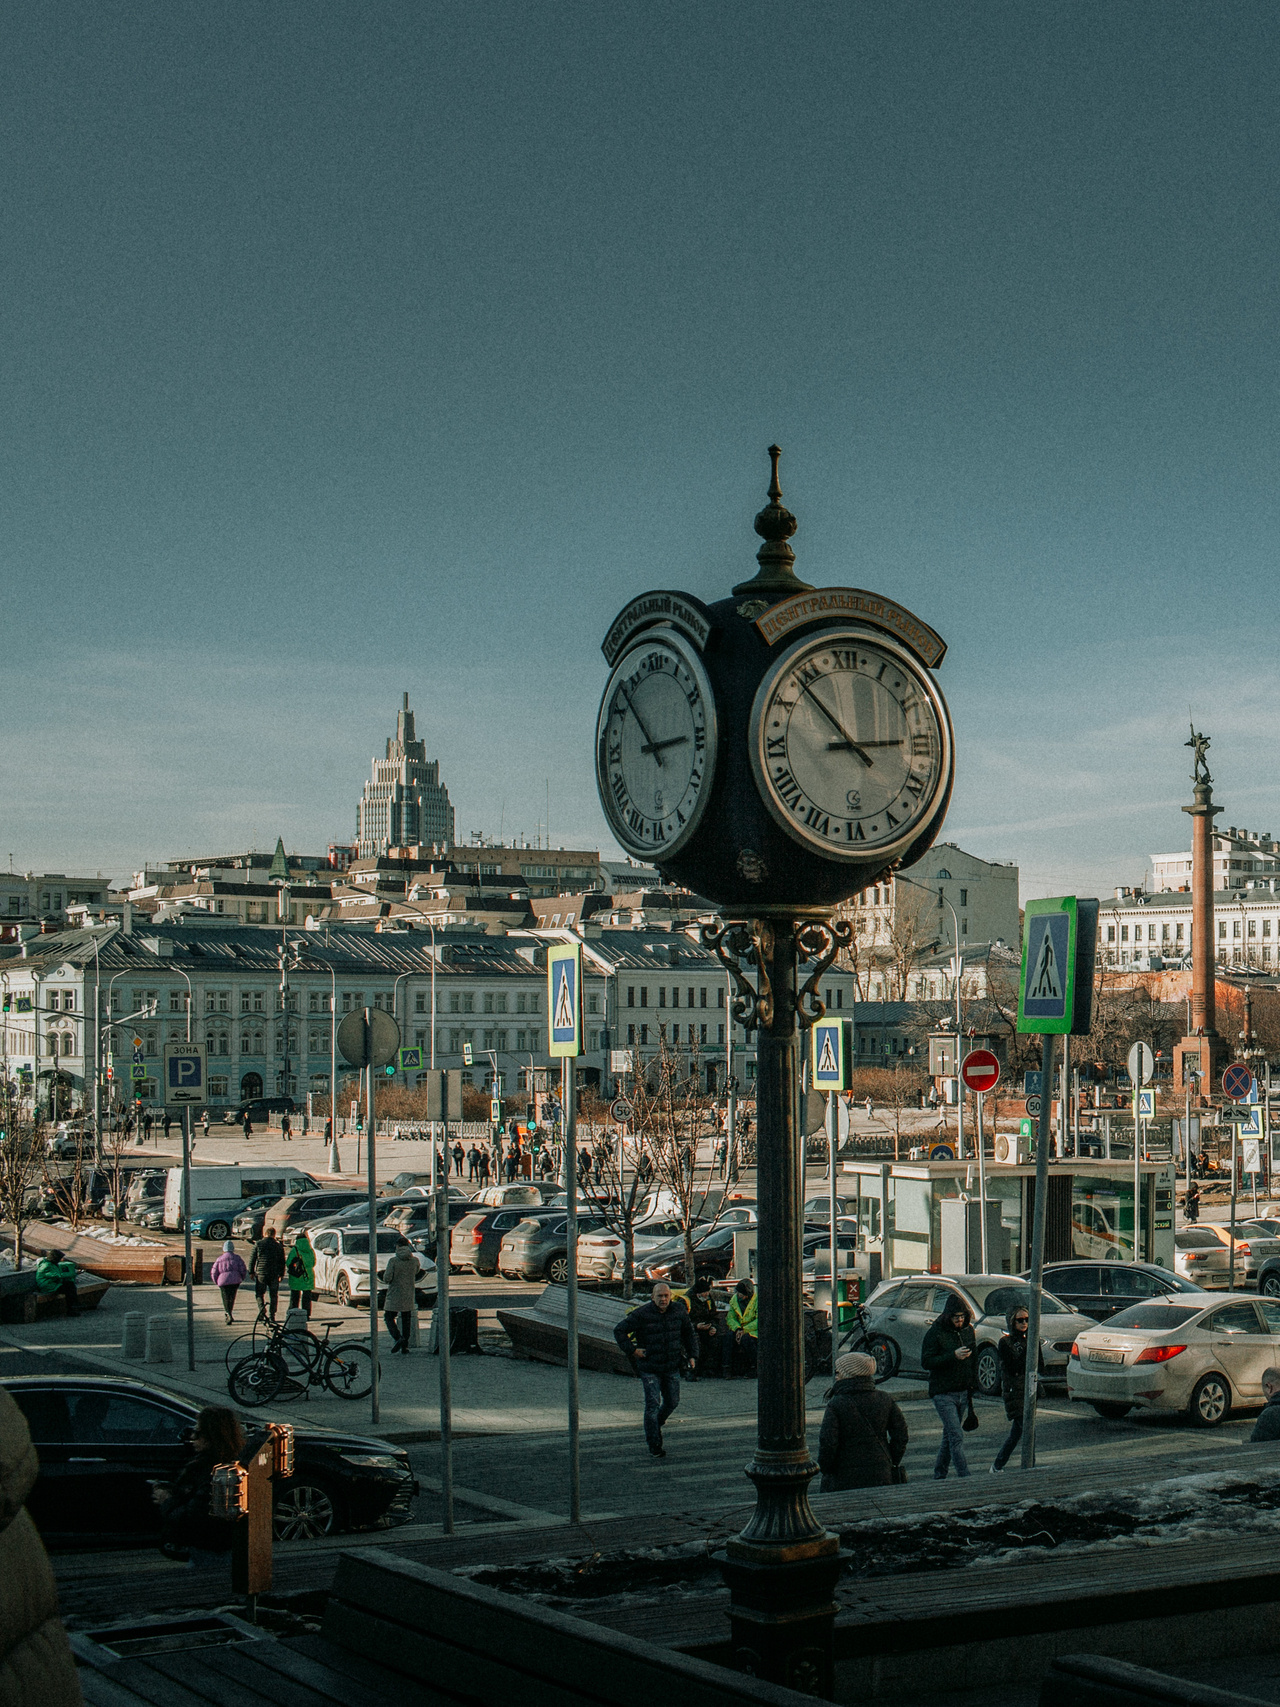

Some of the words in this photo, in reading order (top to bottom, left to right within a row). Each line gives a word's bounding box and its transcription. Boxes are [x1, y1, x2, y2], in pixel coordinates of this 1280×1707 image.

[762, 594, 886, 636] ЦЕНТРАЛЬНЫЙ
[887, 609, 937, 659] РЫНОК
[831, 650, 859, 670] XII
[797, 658, 822, 686] XI
[876, 663, 888, 681] I
[773, 693, 793, 714] X
[767, 735, 786, 759] IX
[913, 734, 930, 756] III
[775, 769, 802, 811] VIII
[906, 774, 925, 799] IV
[804, 806, 830, 836] VII
[886, 810, 900, 829] V
[846, 822, 866, 841] VI
[174, 1046, 198, 1054] ЗОНА
[1030, 1101, 1041, 1111] 50
